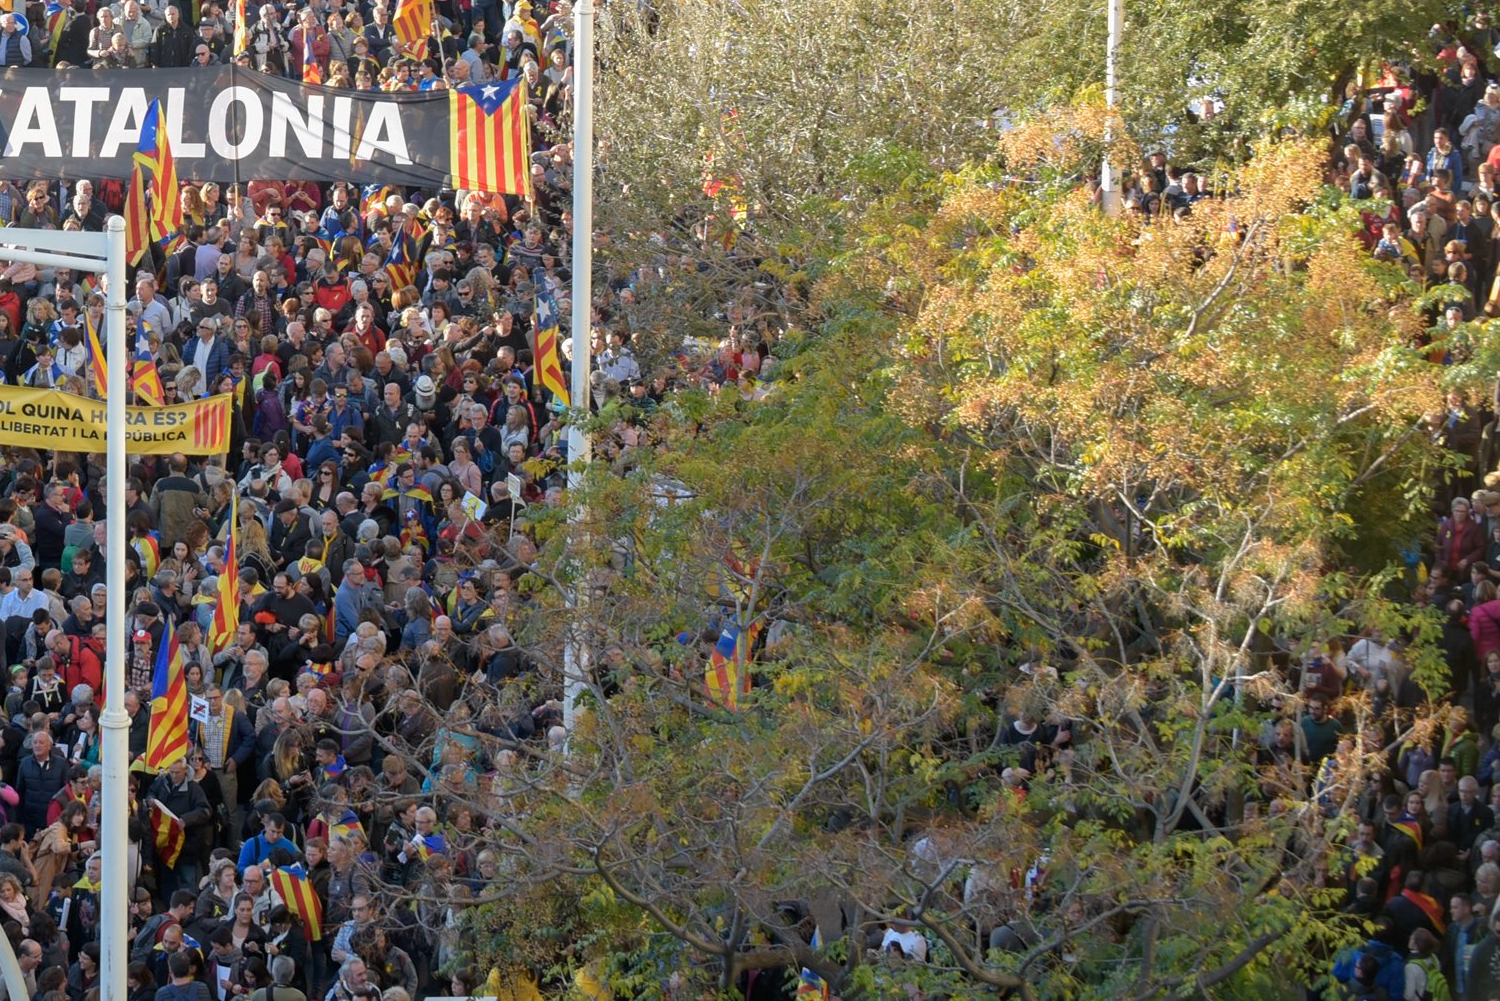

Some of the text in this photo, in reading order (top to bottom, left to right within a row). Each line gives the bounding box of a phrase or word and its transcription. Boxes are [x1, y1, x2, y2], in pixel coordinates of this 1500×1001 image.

[21, 403, 84, 422] QUINA
[90, 409, 147, 425] HRA
[153, 408, 187, 426] ÉS?
[72, 428, 76, 438] I
[81, 429, 99, 440] LA
